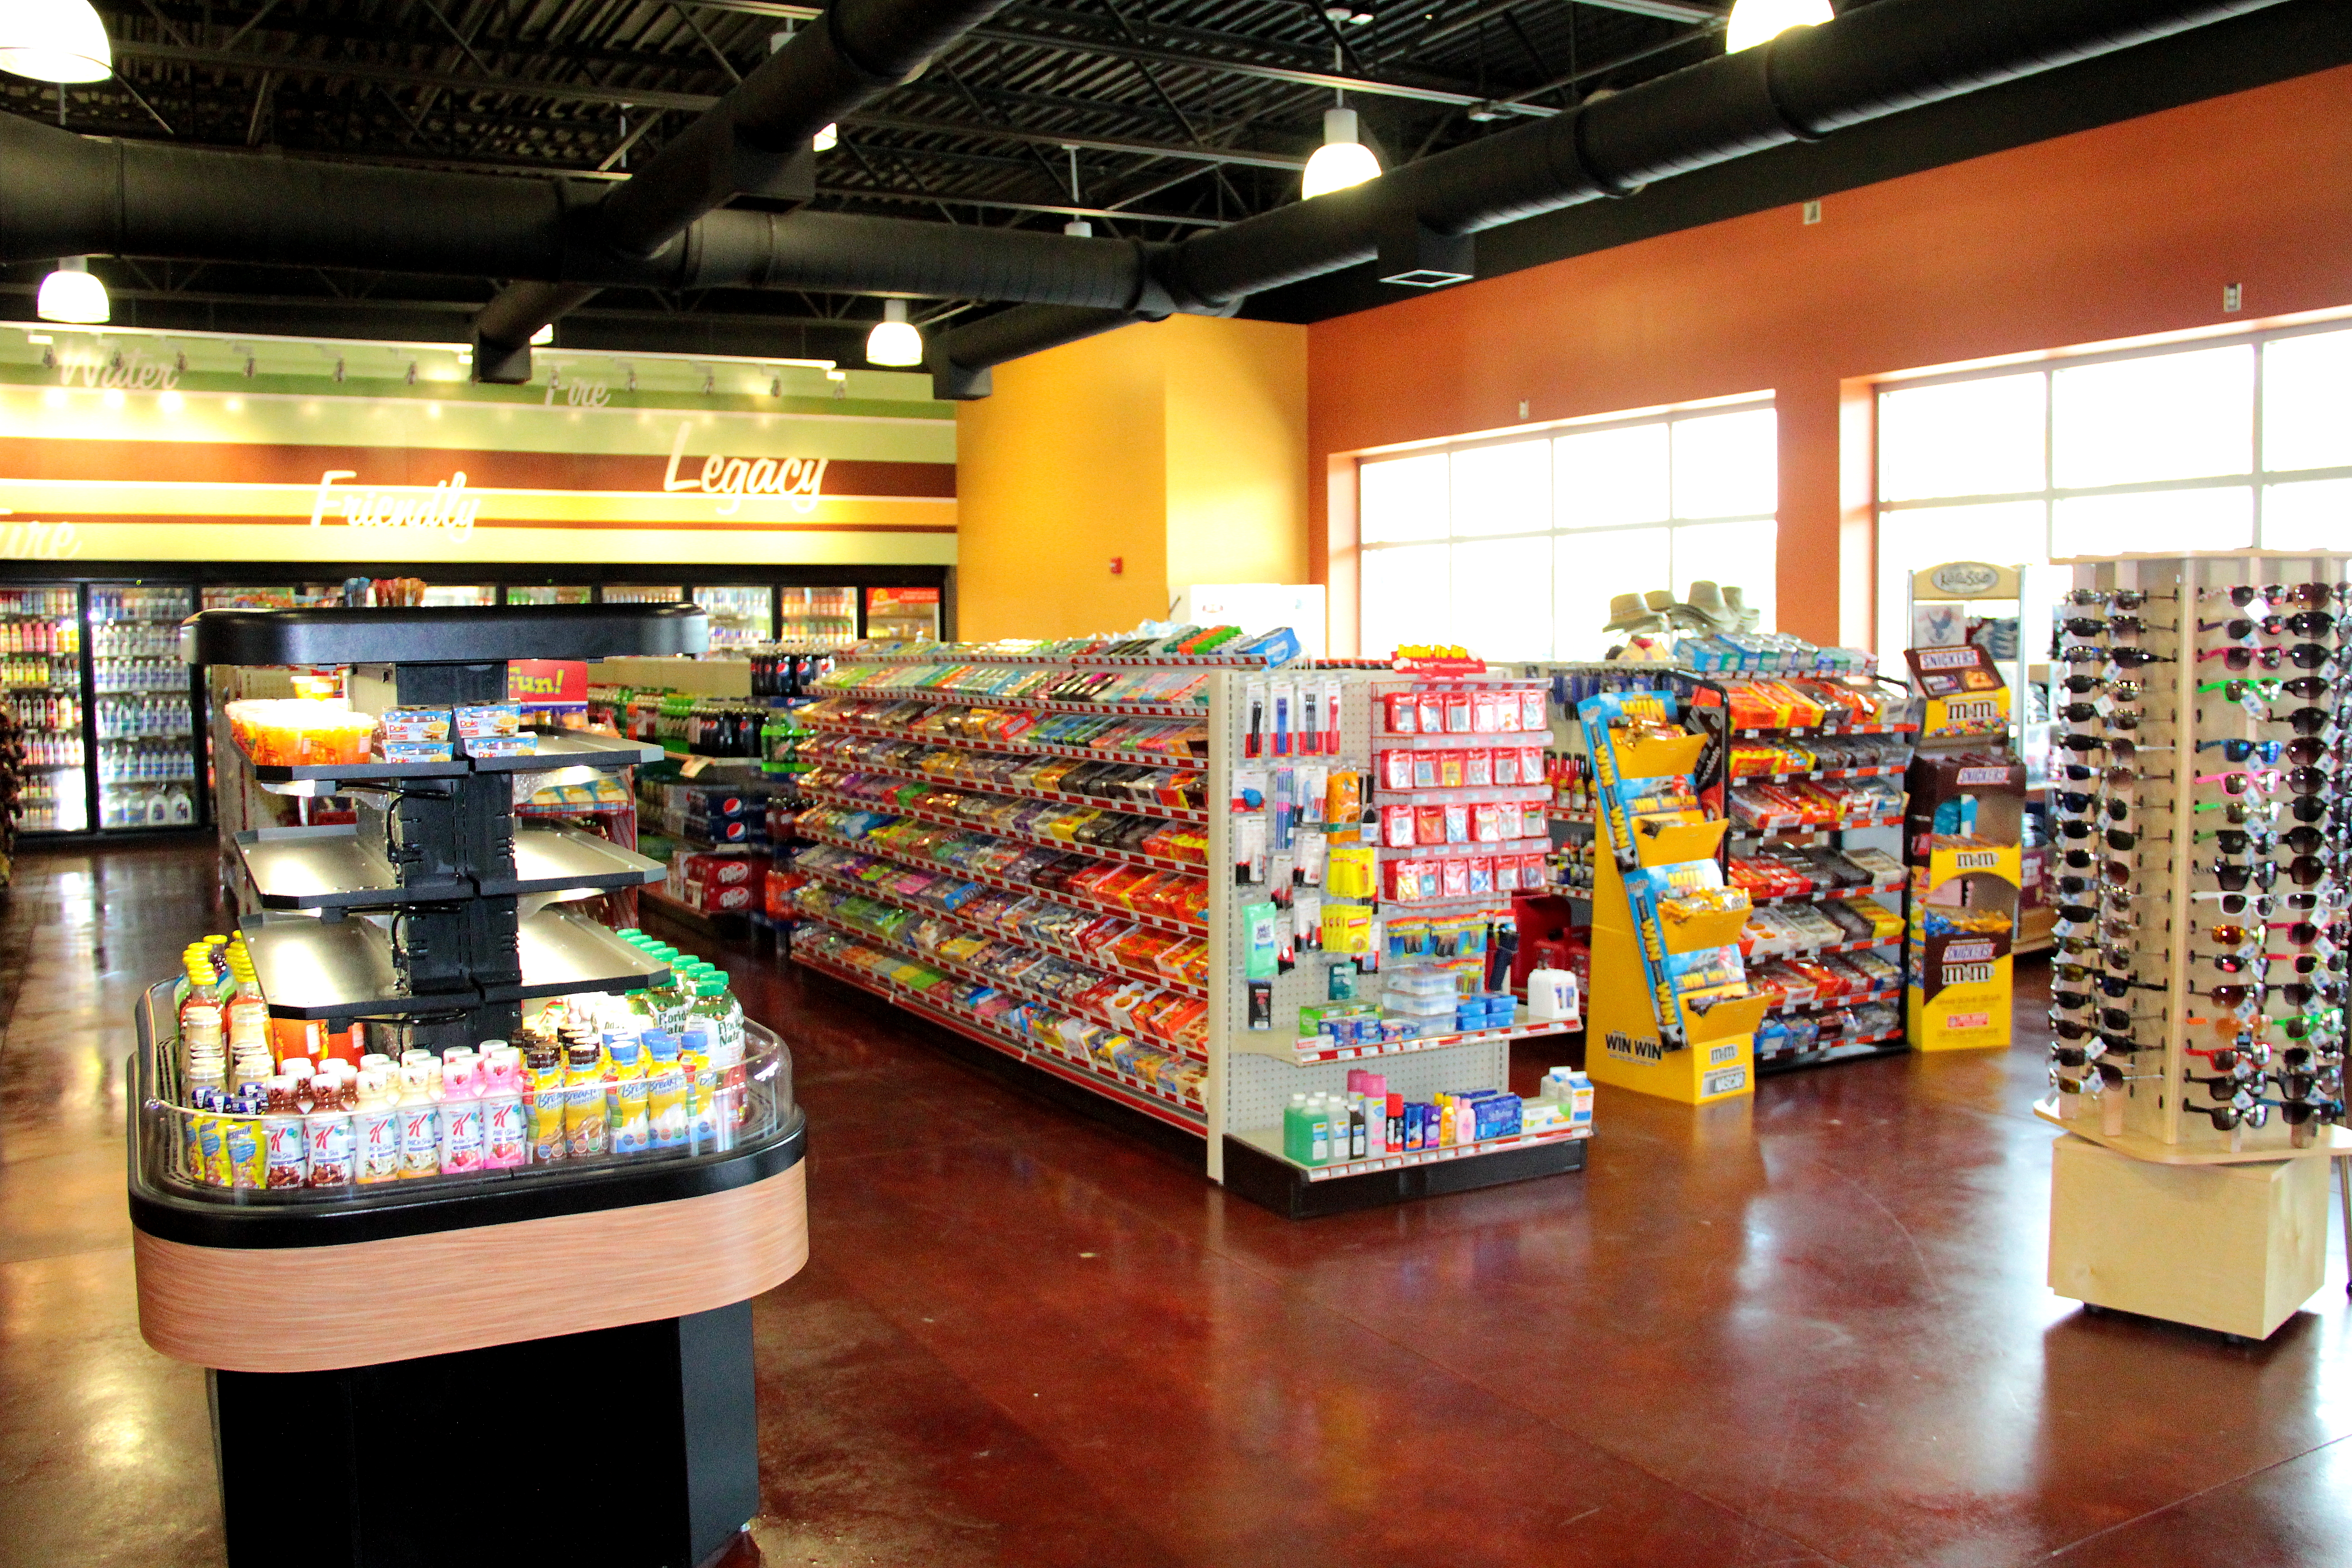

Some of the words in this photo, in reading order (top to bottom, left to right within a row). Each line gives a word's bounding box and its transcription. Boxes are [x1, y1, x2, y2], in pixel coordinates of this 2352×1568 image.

[664, 421, 829, 515] Legacy
[310, 470, 481, 544] Friendly
[1620, 698, 1667, 723] WIN
[1605, 1033, 1632, 1054] WIN
[1634, 1039, 1663, 1060] WIN
[408, 1113, 428, 1137] K
[453, 1112, 472, 1136] K
[494, 1104, 513, 1128] K
[270, 1128, 287, 1152] K
[315, 1125, 336, 1150] K
[369, 1119, 389, 1144] K
